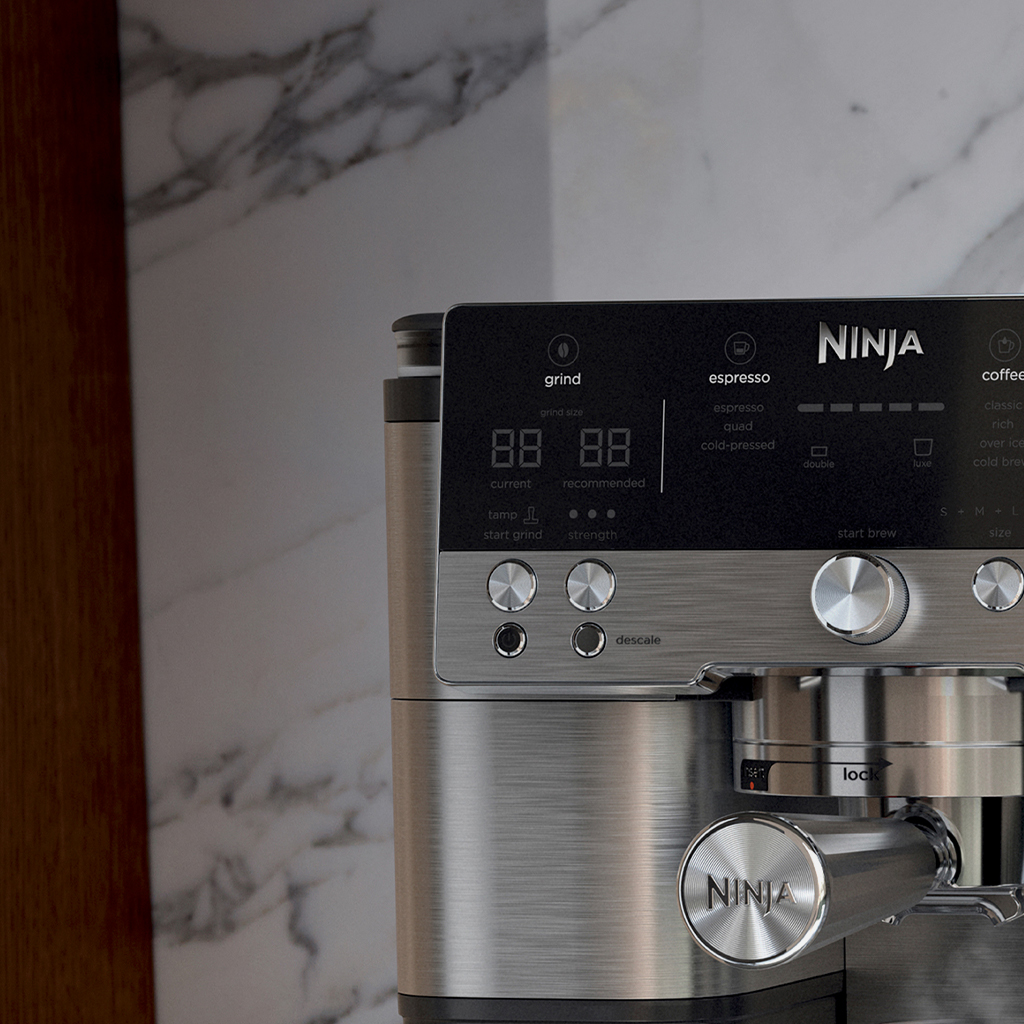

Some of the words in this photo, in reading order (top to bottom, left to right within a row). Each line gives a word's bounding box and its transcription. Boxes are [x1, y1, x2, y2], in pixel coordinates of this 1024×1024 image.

[817, 320, 925, 372] NINJA
[544, 372, 582, 388] grind
[708, 372, 771, 386] espresso
[713, 402, 765, 415] espresso
[984, 400, 1023, 411] classic
[539, 407, 563, 418] grind
[565, 407, 584, 417] size
[723, 421, 753, 433] quad
[991, 417, 1014, 430] rich
[700, 439, 776, 452] cold-pressed
[979, 439, 1006, 449] over
[803, 459, 835, 470] double
[913, 458, 932, 469] luxe
[973, 456, 996, 468] cold
[489, 478, 532, 490] current
[562, 477, 646, 489] recommended
[488, 509, 518, 521] tamp
[940, 506, 948, 517] S
[974, 506, 985, 516] M
[1011, 505, 1019, 517] L
[483, 528, 509, 540] start
[512, 528, 543, 542] grind
[567, 529, 618, 542] strength
[837, 527, 865, 539] start
[867, 527, 898, 539] brew
[988, 527, 1012, 538] size
[615, 634, 662, 645] descale
[843, 767, 880, 781] lock
[708, 874, 797, 916] NINJA
